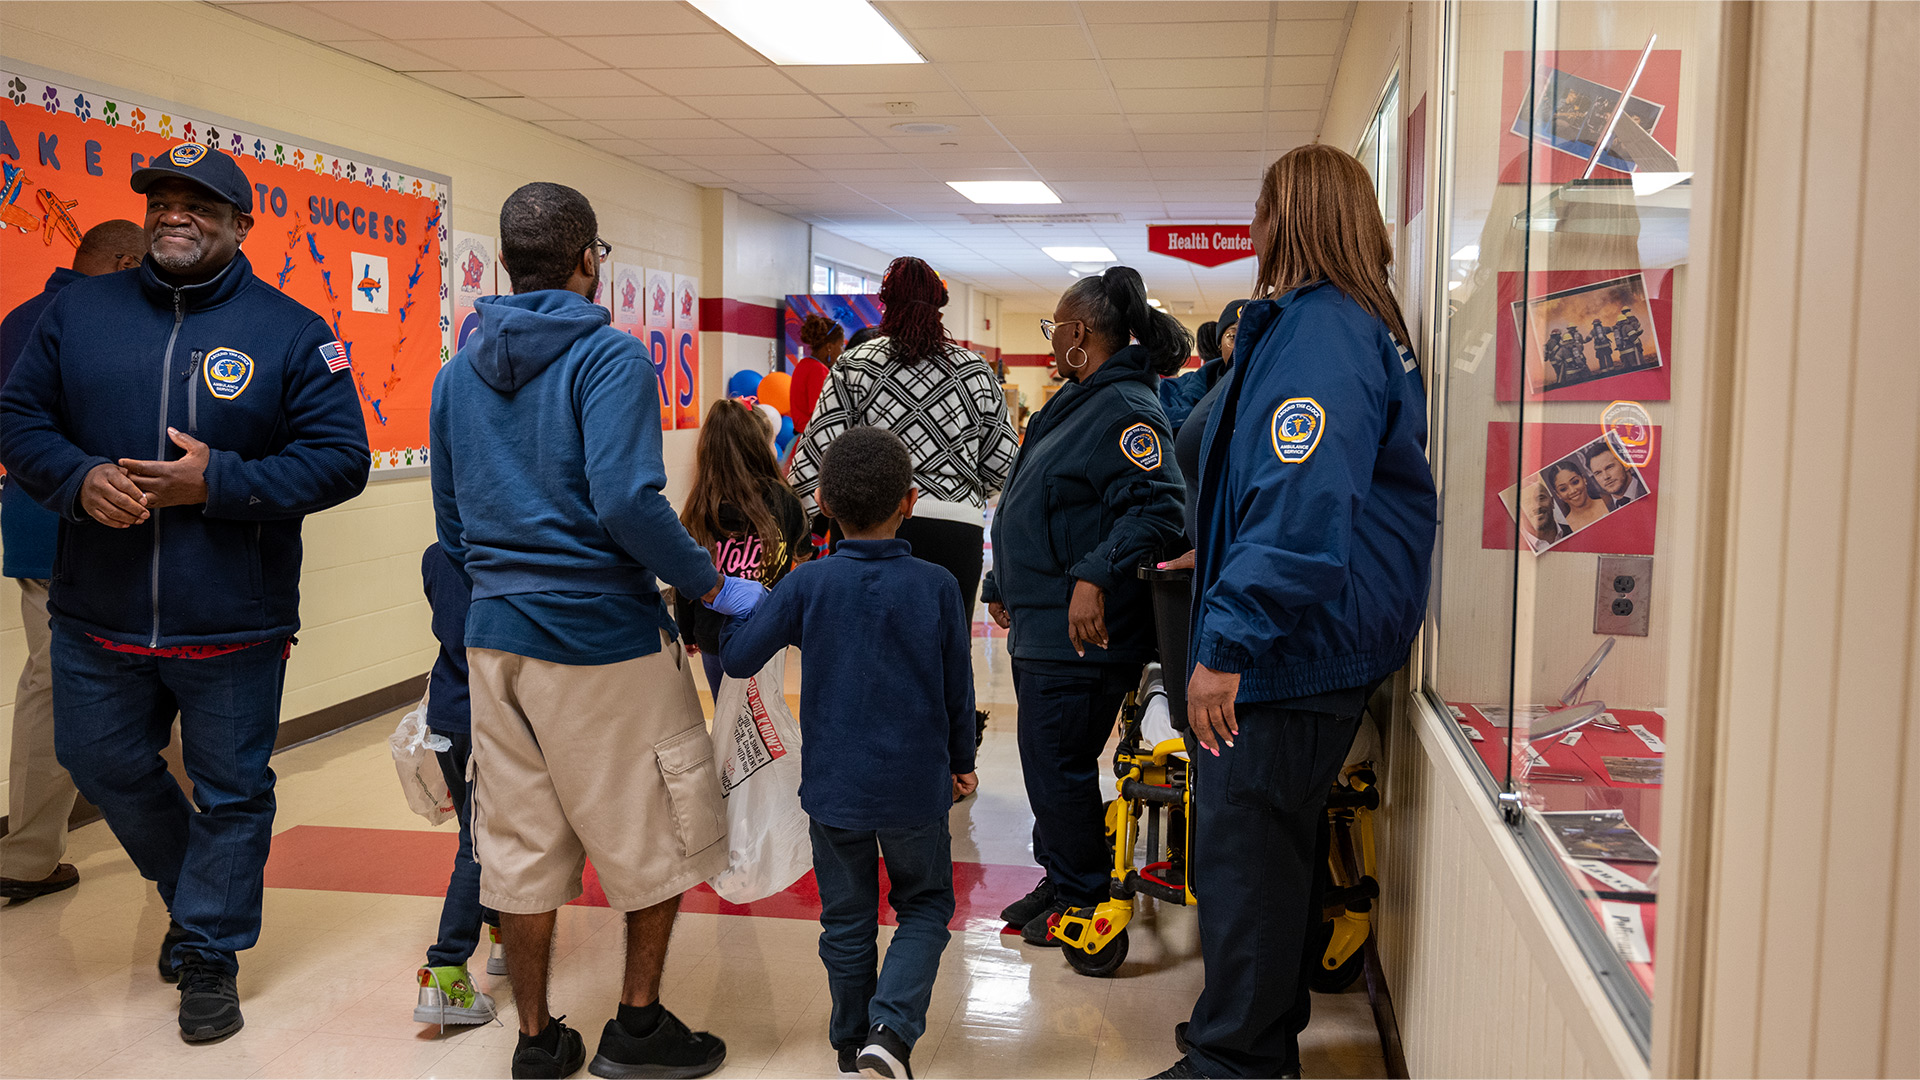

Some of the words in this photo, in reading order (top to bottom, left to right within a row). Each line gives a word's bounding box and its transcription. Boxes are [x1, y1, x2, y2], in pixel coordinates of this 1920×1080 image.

[255, 183, 288, 218] TO
[309, 195, 407, 246] SUCCESS
[1168, 232, 1209, 250] Health
[1212, 231, 1252, 251] Center
[1305, 404, 1321, 419] CLOCK
[751, 697, 765, 716] YOU
[757, 716, 783, 752] KNOW?
[750, 738, 763, 758] SHARE
